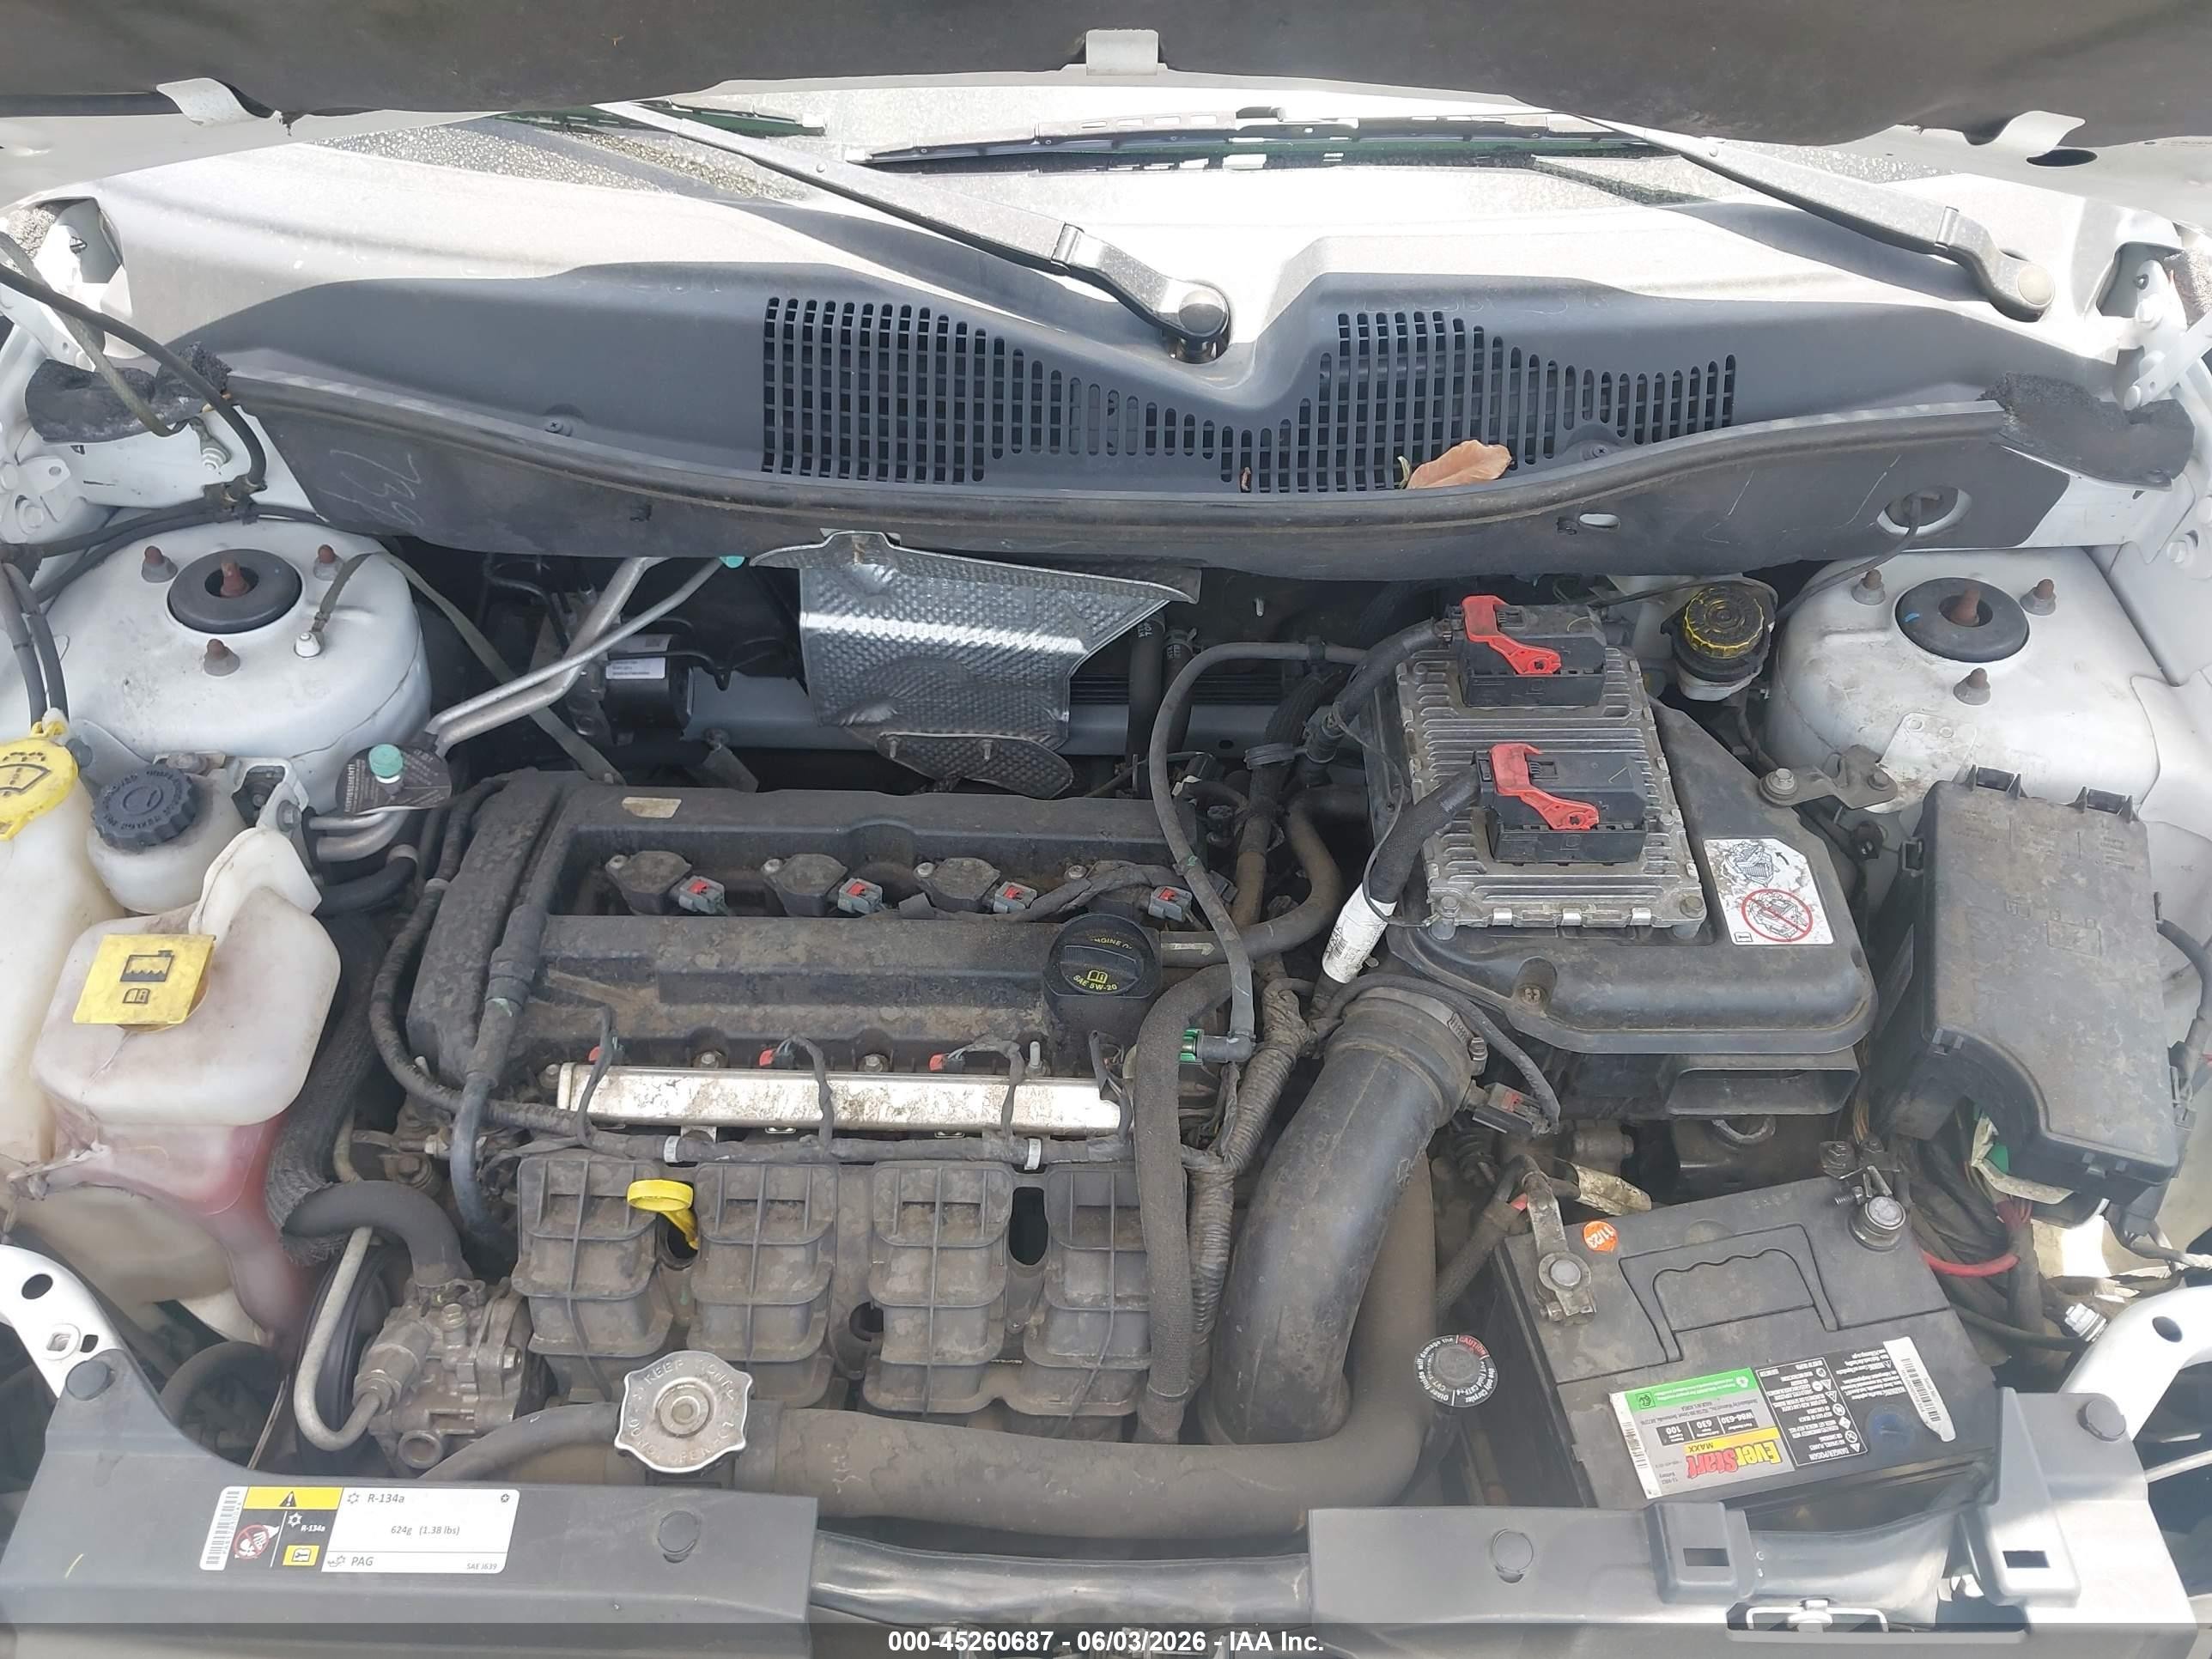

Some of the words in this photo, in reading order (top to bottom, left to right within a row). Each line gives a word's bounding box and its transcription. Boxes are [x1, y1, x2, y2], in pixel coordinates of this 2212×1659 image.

[1073, 975, 1088, 986] SAE
[1089, 981, 1118, 992] 5W-20
[1419, 1340, 1442, 1358] damage
[1460, 1337, 1486, 1356] CAUTION
[1415, 1358, 1424, 1370] will
[644, 1359, 684, 1385] KEEP
[1419, 1370, 1431, 1390] fluids
[1430, 1389, 1449, 1401] Other
[1666, 1425, 1681, 1434] 100
[1697, 1419, 1712, 1429] 630
[1688, 1442, 1714, 1453] MAXX
[1686, 1440, 1782, 1479] EverStart
[368, 1493, 404, 1504] R-134a
[391, 1526, 412, 1535] 624g
[419, 1526, 441, 1535] (1.38
[443, 1526, 460, 1535] lbs)
[351, 1557, 374, 1567] PAG
